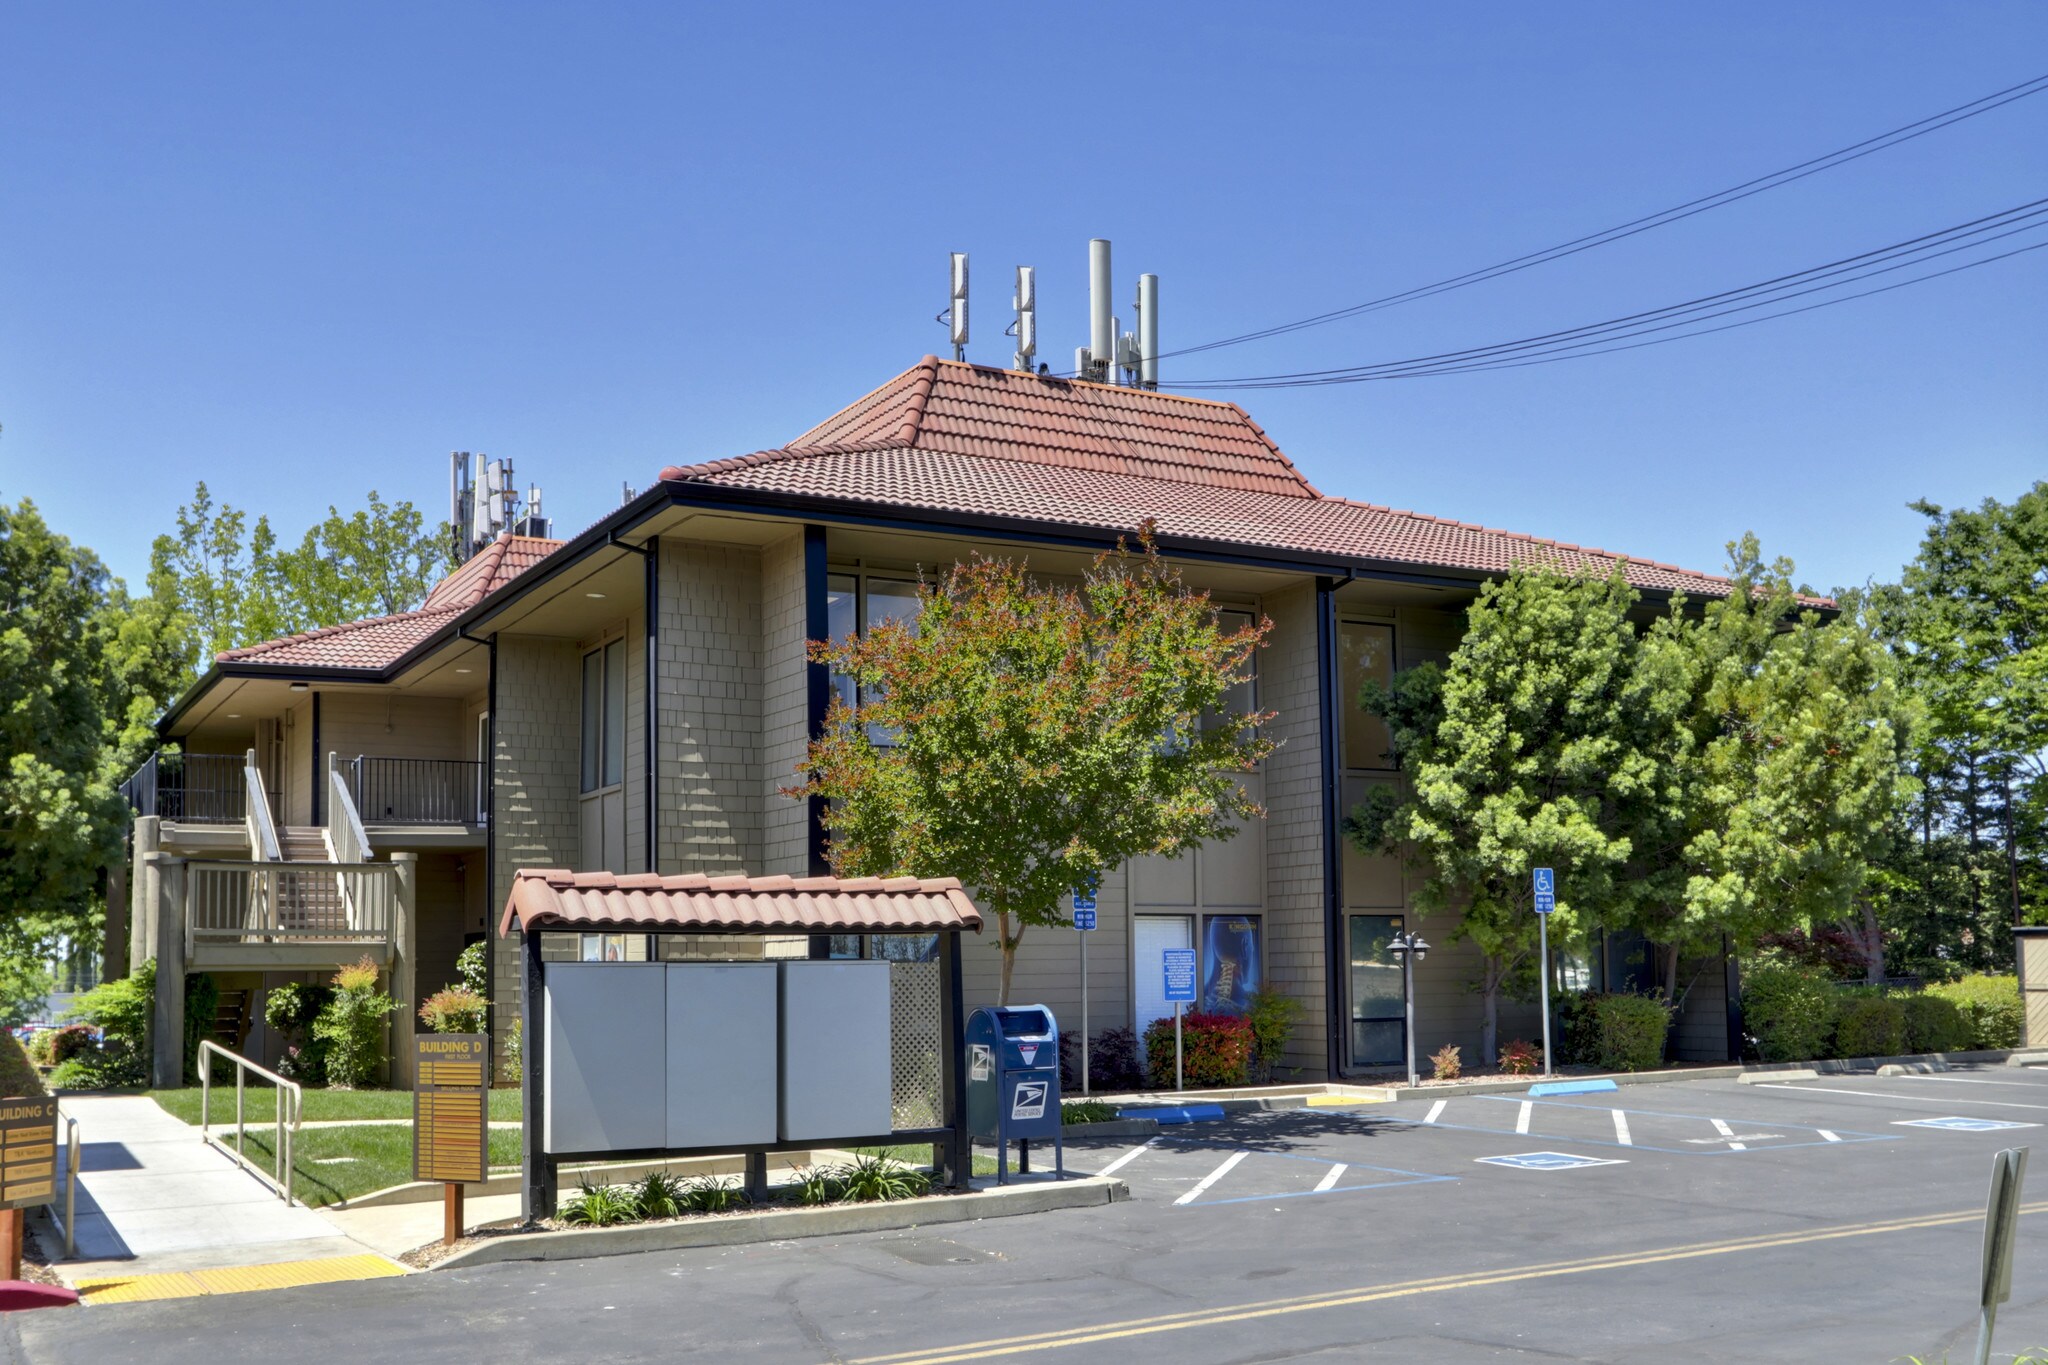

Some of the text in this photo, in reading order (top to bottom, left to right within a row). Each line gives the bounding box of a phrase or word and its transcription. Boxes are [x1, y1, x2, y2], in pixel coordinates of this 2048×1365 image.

[419, 1041, 482, 1053] BUILDING D
[0, 1103, 54, 1120] UILDING C
